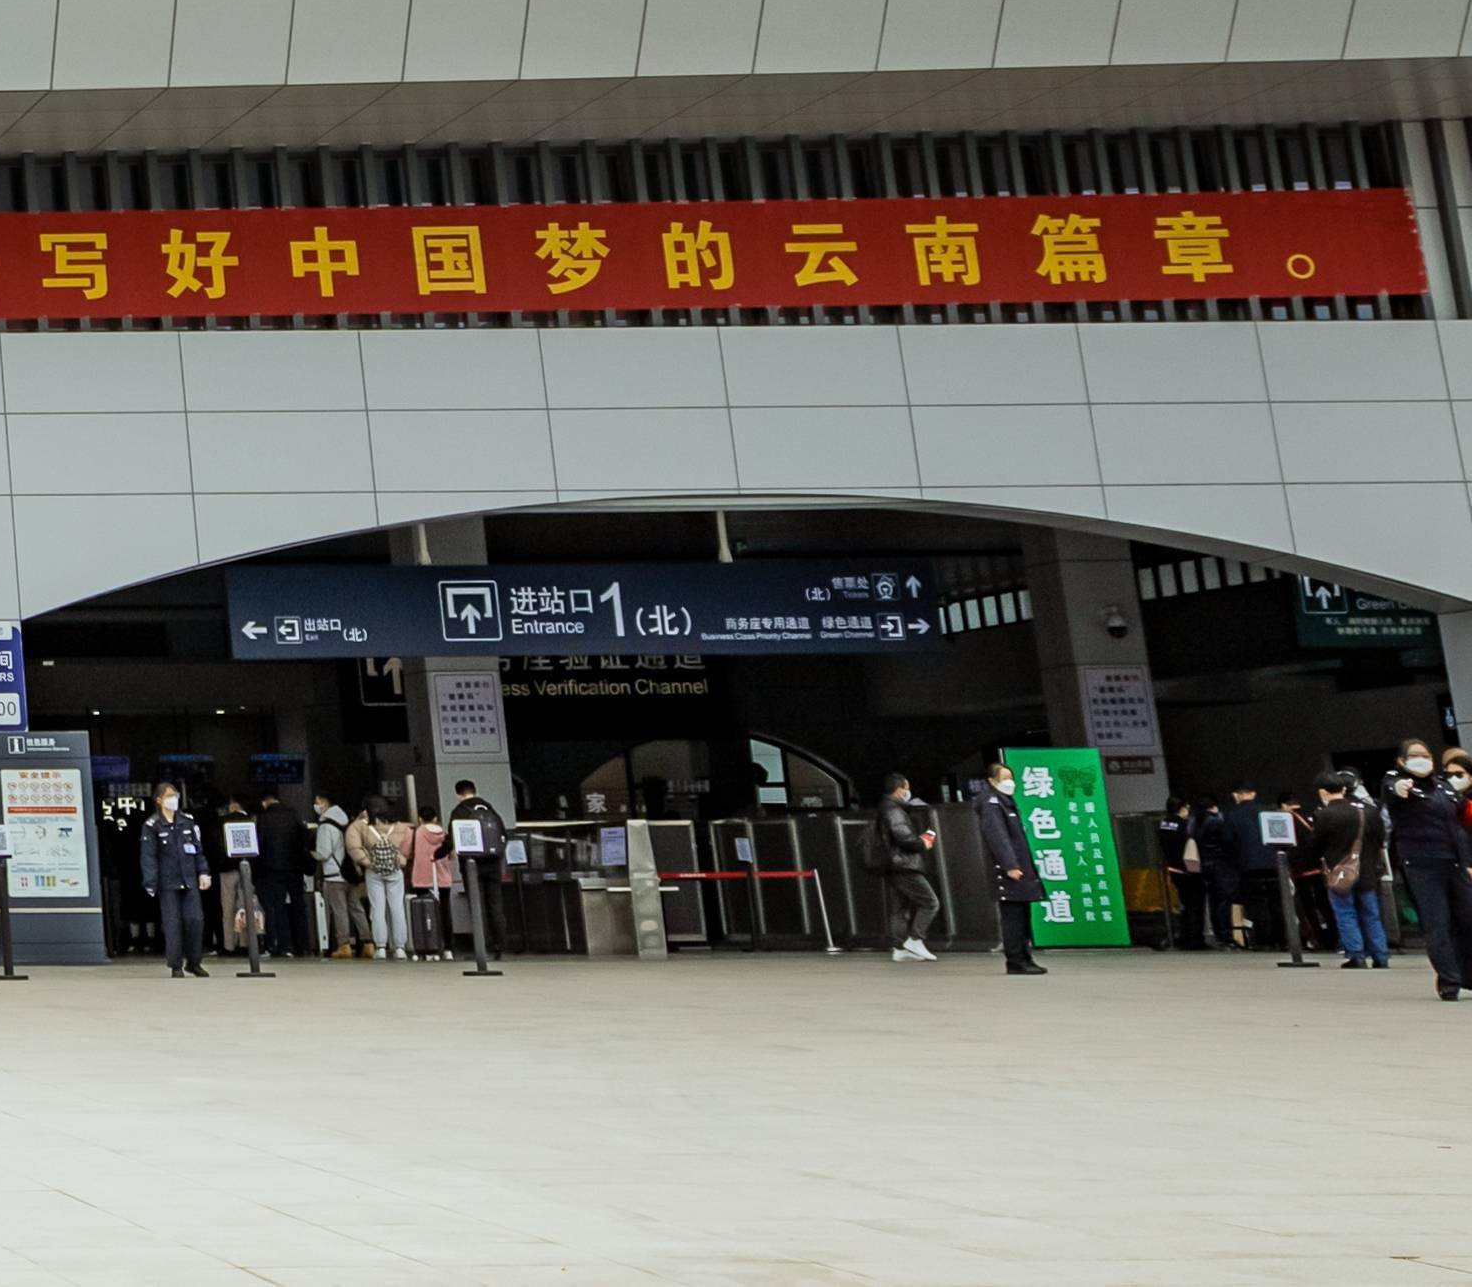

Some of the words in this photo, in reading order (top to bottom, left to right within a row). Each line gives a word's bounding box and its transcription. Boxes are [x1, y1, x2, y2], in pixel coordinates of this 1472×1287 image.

[510, 586, 593, 615] 进站口
[305, 618, 344, 631] 出站口
[512, 619, 584, 634] Entrance
[726, 617, 809, 629] 商务座专用通道
[822, 616, 872, 632] 绿色通道
[534, 679, 632, 696] Verification
[635, 677, 708, 695] Channel
[1021, 766, 1074, 922] 绿色通道
